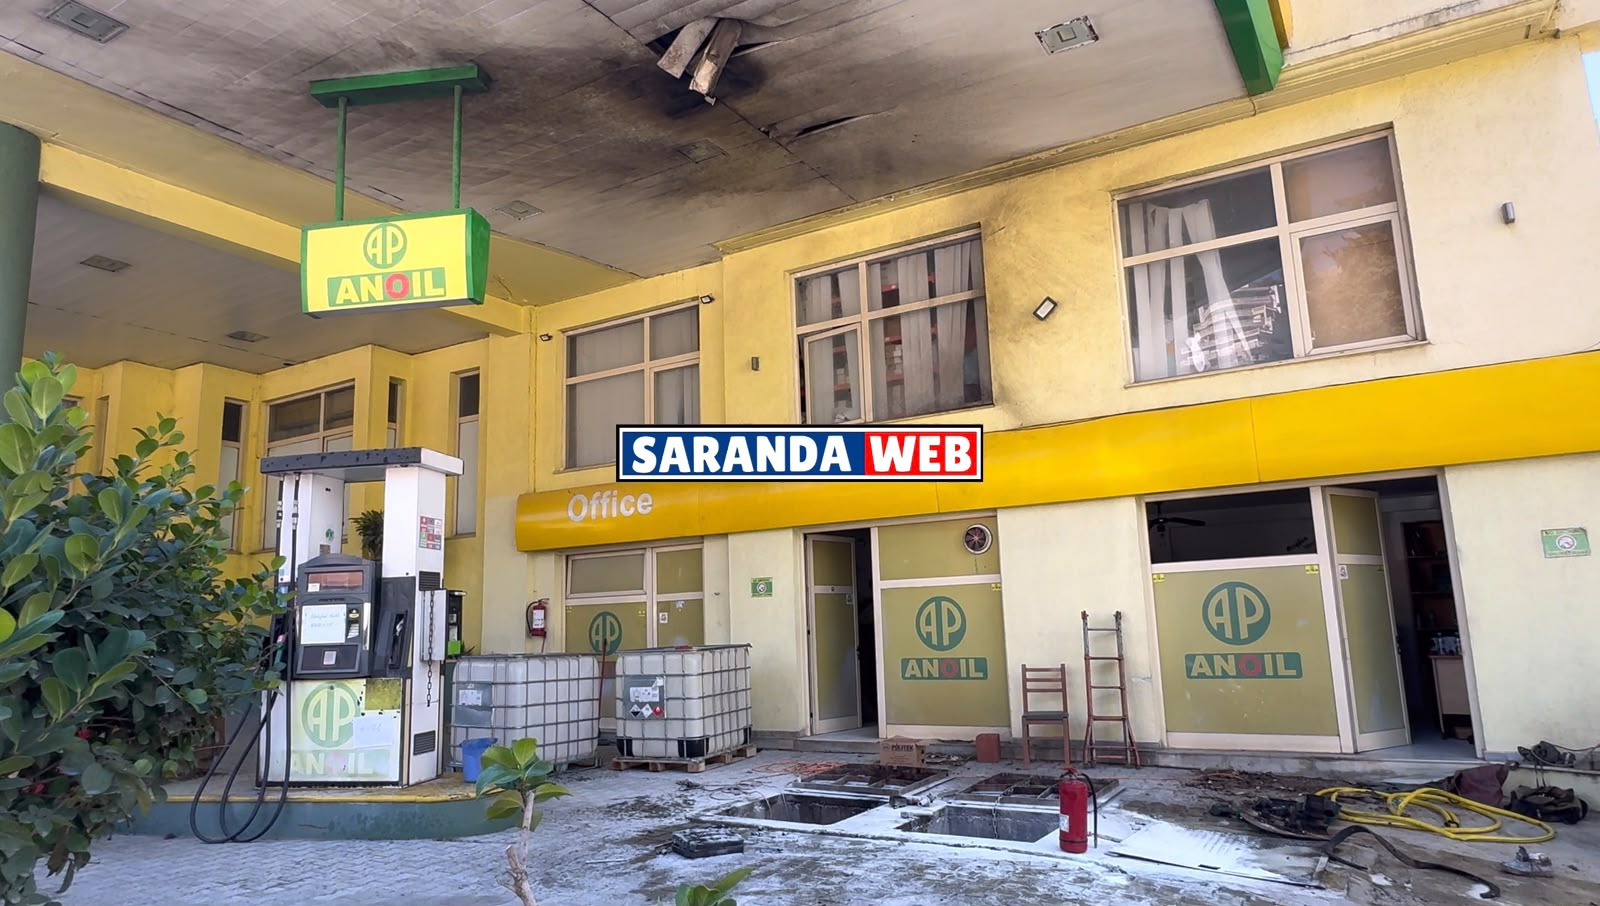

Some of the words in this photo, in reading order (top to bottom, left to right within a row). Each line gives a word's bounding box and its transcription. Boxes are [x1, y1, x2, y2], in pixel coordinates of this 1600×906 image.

[336, 271, 445, 304] ANOIL
[567, 491, 653, 522] Office
[920, 600, 961, 646] AP
[1208, 587, 1265, 639] AP
[904, 658, 984, 678] ANOIL
[1191, 654, 1296, 676] ANOIL
